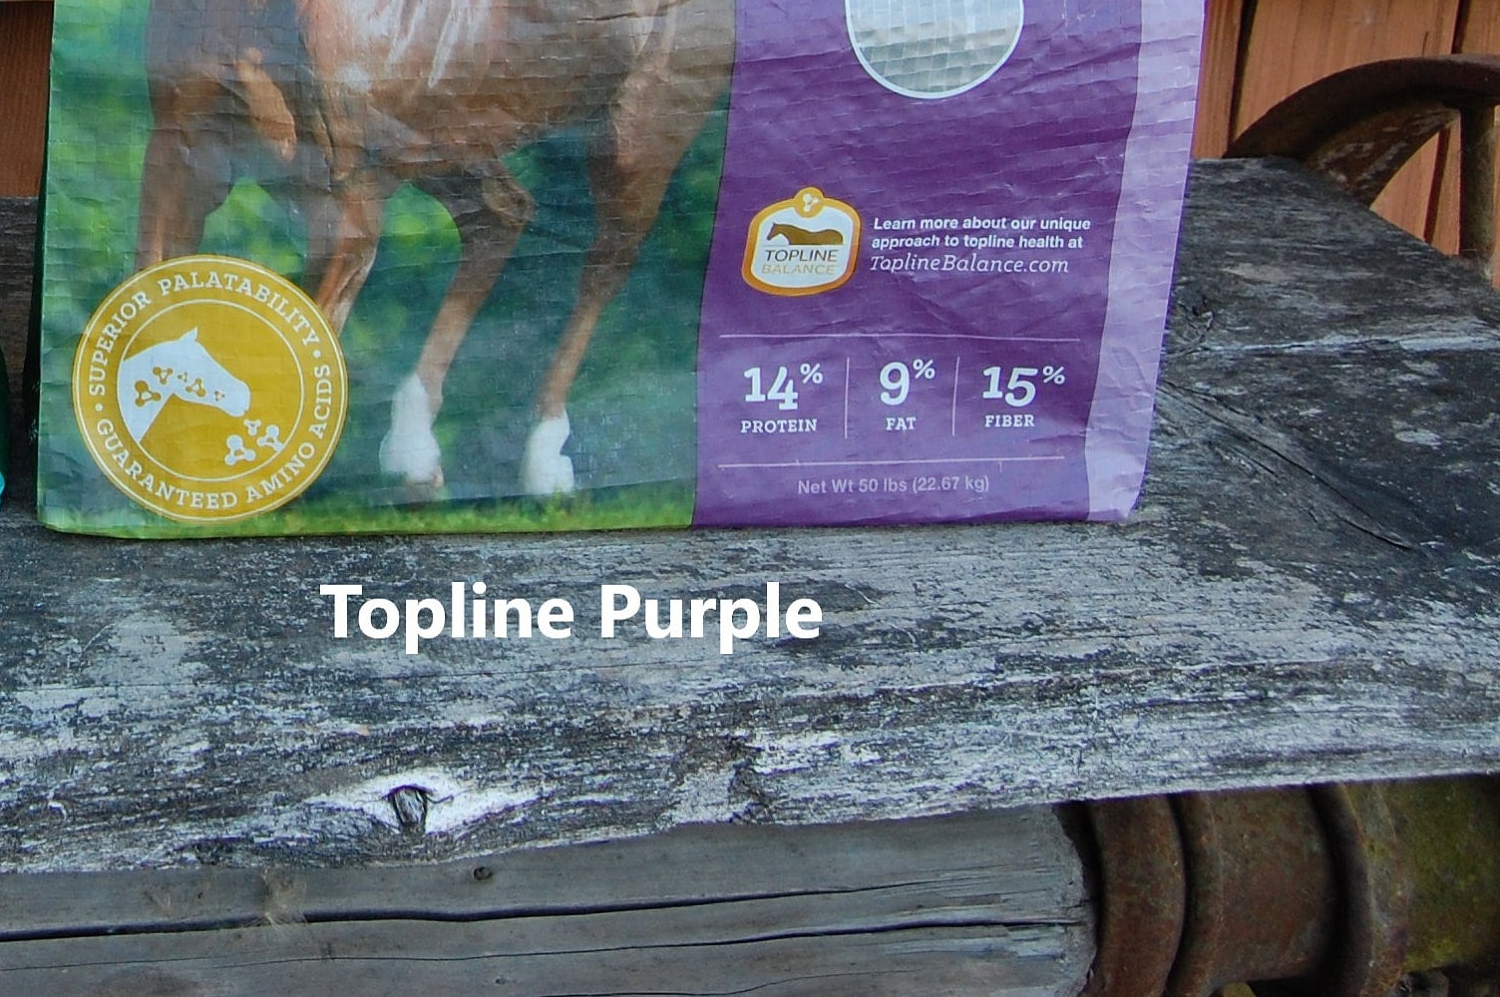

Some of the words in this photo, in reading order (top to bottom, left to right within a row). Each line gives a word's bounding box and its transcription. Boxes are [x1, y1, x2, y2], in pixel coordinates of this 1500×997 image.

[873, 217, 916, 230] Learn
[920, 219, 959, 229] more
[962, 216, 1007, 230] about
[1010, 218, 1037, 230] our
[1040, 217, 1091, 232] unique
[872, 234, 940, 251] approach
[944, 235, 960, 247] to
[963, 234, 1015, 250] topline
[1019, 235, 1064, 249] health
[1068, 236, 1083, 249] at
[765, 249, 839, 262] TOPLINE
[869, 252, 1069, 273] ToplineBalance.com
[761, 264, 835, 276] BALANCE
[89, 290, 152, 396] SUPERIOR
[157, 271, 321, 347] PALATABILITY
[743, 363, 824, 411] 14%
[879, 359, 936, 406] 9%
[982, 365, 1066, 408] 15%
[741, 417, 818, 435] PROTEIN
[885, 416, 917, 431] FAT
[984, 414, 1036, 429] FIBER
[96, 418, 237, 510] GUARANTEED
[246, 442, 316, 504] AMINO
[308, 364, 333, 440] ACIDS
[798, 480, 827, 495] Net
[832, 479, 854, 493] Wt
[858, 478, 879, 492] 50
[884, 477, 908, 492] lbs
[912, 476, 960, 494] (22.67
[964, 475, 990, 494] kg)
